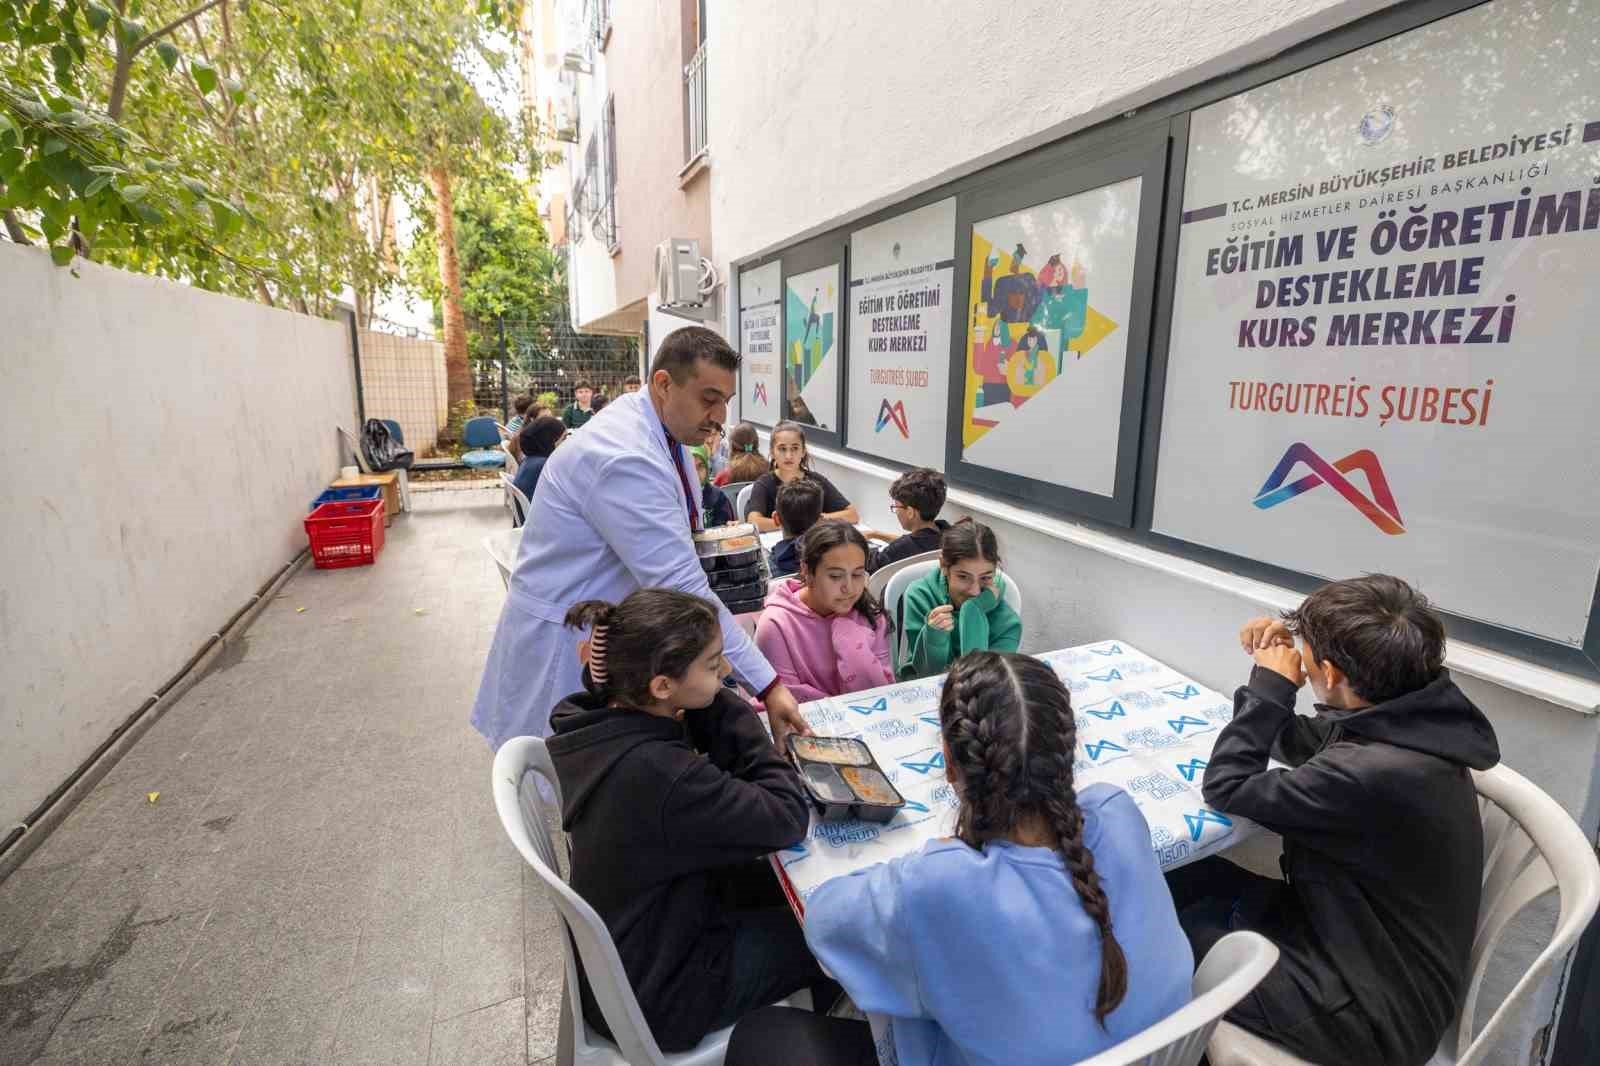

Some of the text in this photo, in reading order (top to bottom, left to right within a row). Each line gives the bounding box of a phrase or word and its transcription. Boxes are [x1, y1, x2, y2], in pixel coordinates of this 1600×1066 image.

[1232, 123, 1572, 213] T.C. MERSİN BÜYÜKŞEHİR BELEDİYESİ
[1206, 176, 1600, 276] EĞİTİM VE ÖĞRETİMİ
[1231, 215, 1275, 232] SOSYAL
[1280, 200, 1351, 224] HİZMETLER
[1359, 185, 1422, 209] DAİRESİ
[858, 295, 883, 315] EĞİTİM
[885, 295, 896, 312] VE
[897, 283, 940, 311] ÖĞRETİMİ
[1255, 256, 1485, 309] DESTEKLEME
[868, 330, 928, 352] KURS MERKEZİ
[872, 313, 921, 333] DESTEKLEME
[1237, 294, 1516, 348] KURS MERKEZİ
[1228, 376, 1494, 428] TURGUTREİS ŞUBESİ
